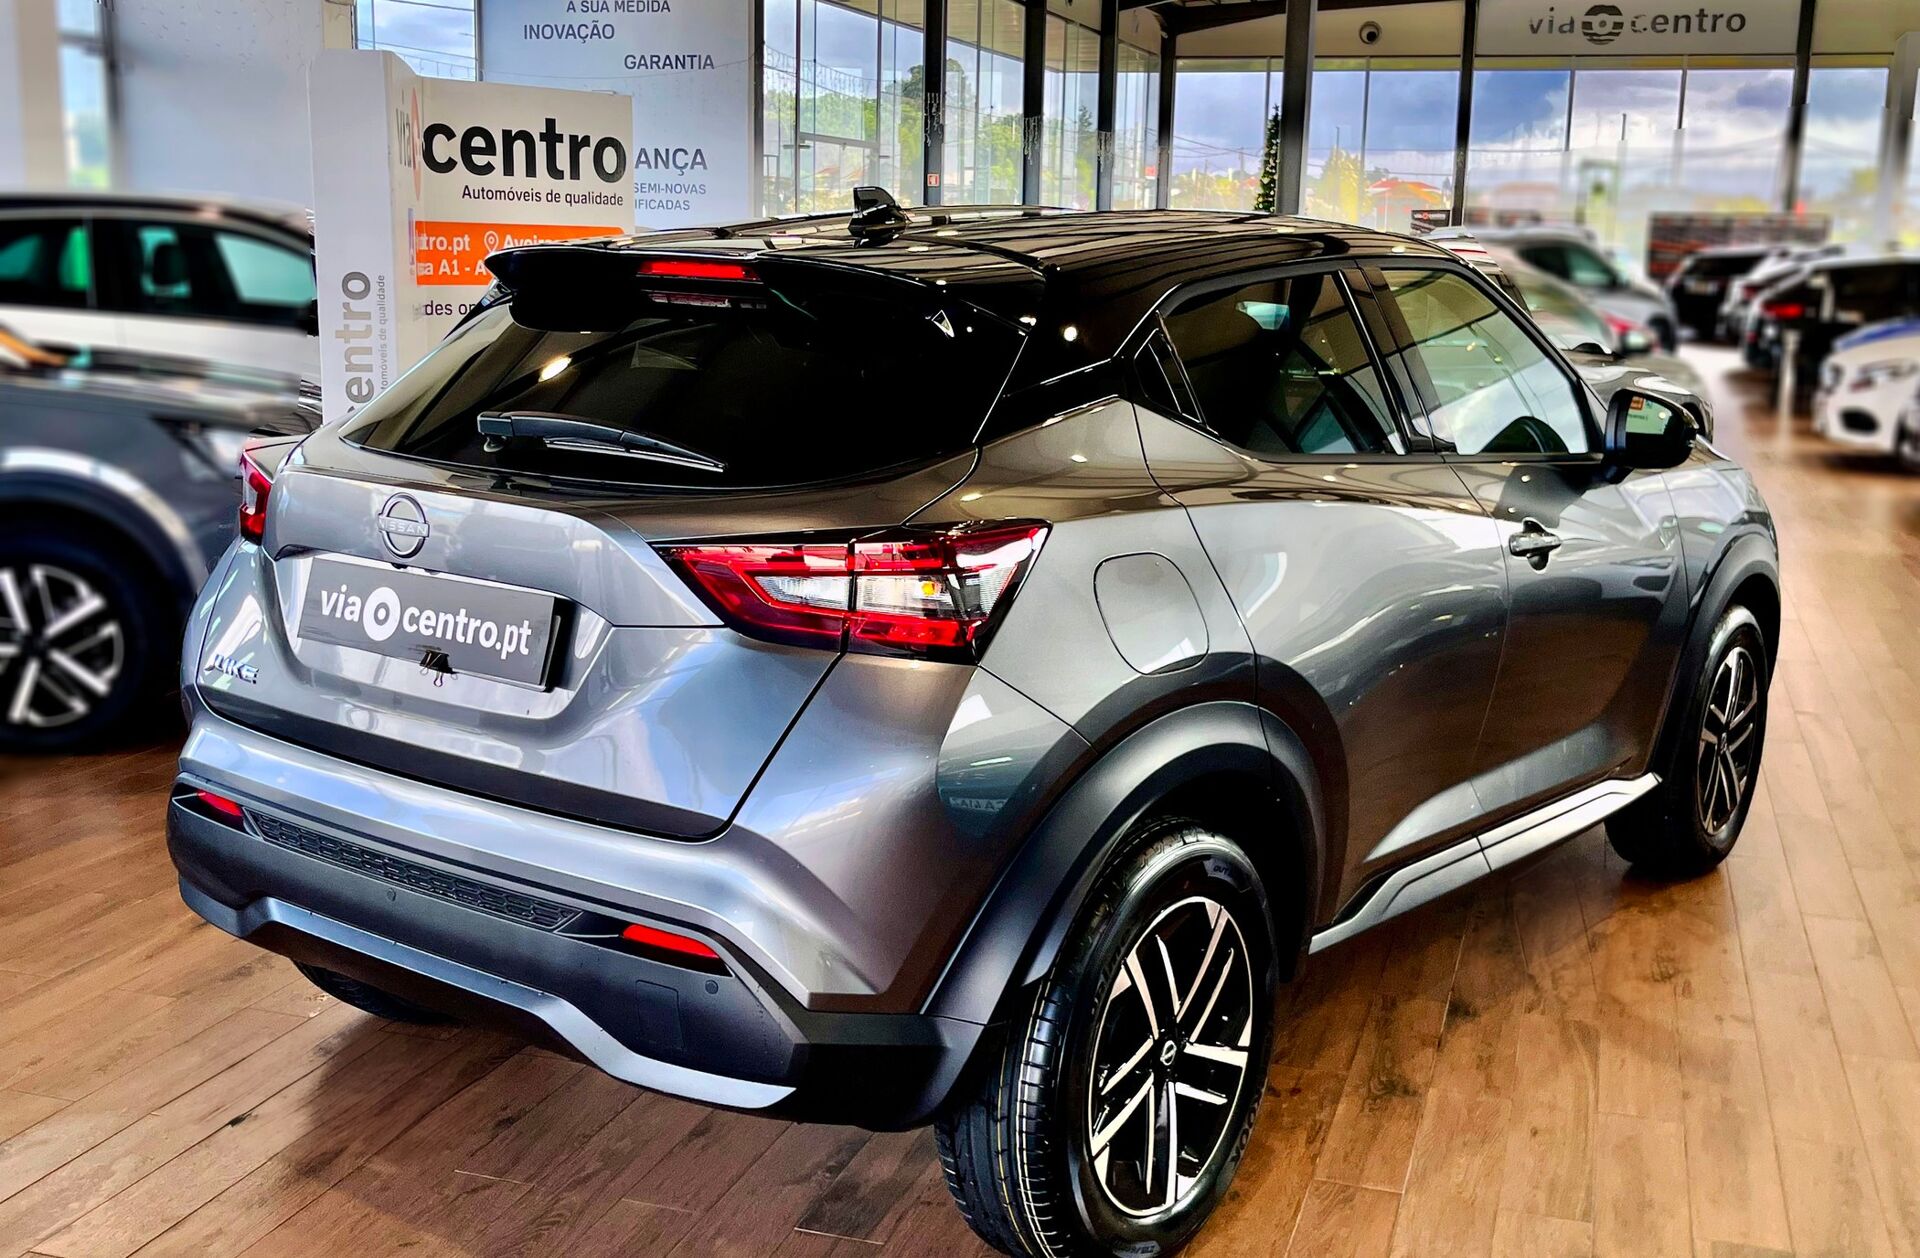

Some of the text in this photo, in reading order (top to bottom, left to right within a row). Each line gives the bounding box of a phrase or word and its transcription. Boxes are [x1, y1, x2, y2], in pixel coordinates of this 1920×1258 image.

[566, 0, 671, 13] A SUA MEDIDA
[524, 20, 615, 44] INOVAÇÃO
[1631, 8, 1747, 34] centro
[624, 54, 715, 70] GARANTIA
[422, 117, 627, 184] centro
[634, 147, 708, 177] ANÇA
[462, 184, 624, 207] Automóveis de qualidade
[634, 182, 707, 195] SEMI-NOVAS
[634, 199, 691, 211] IFICADAS
[416, 232, 555, 256] tro.pt Avei
[438, 258, 460, 276] A1
[376, 274, 388, 325] qualidade
[335, 271, 375, 404] entro
[378, 327, 387, 341] de
[379, 518, 428, 537] NISSAN
[320, 584, 532, 660] via centro.pt
